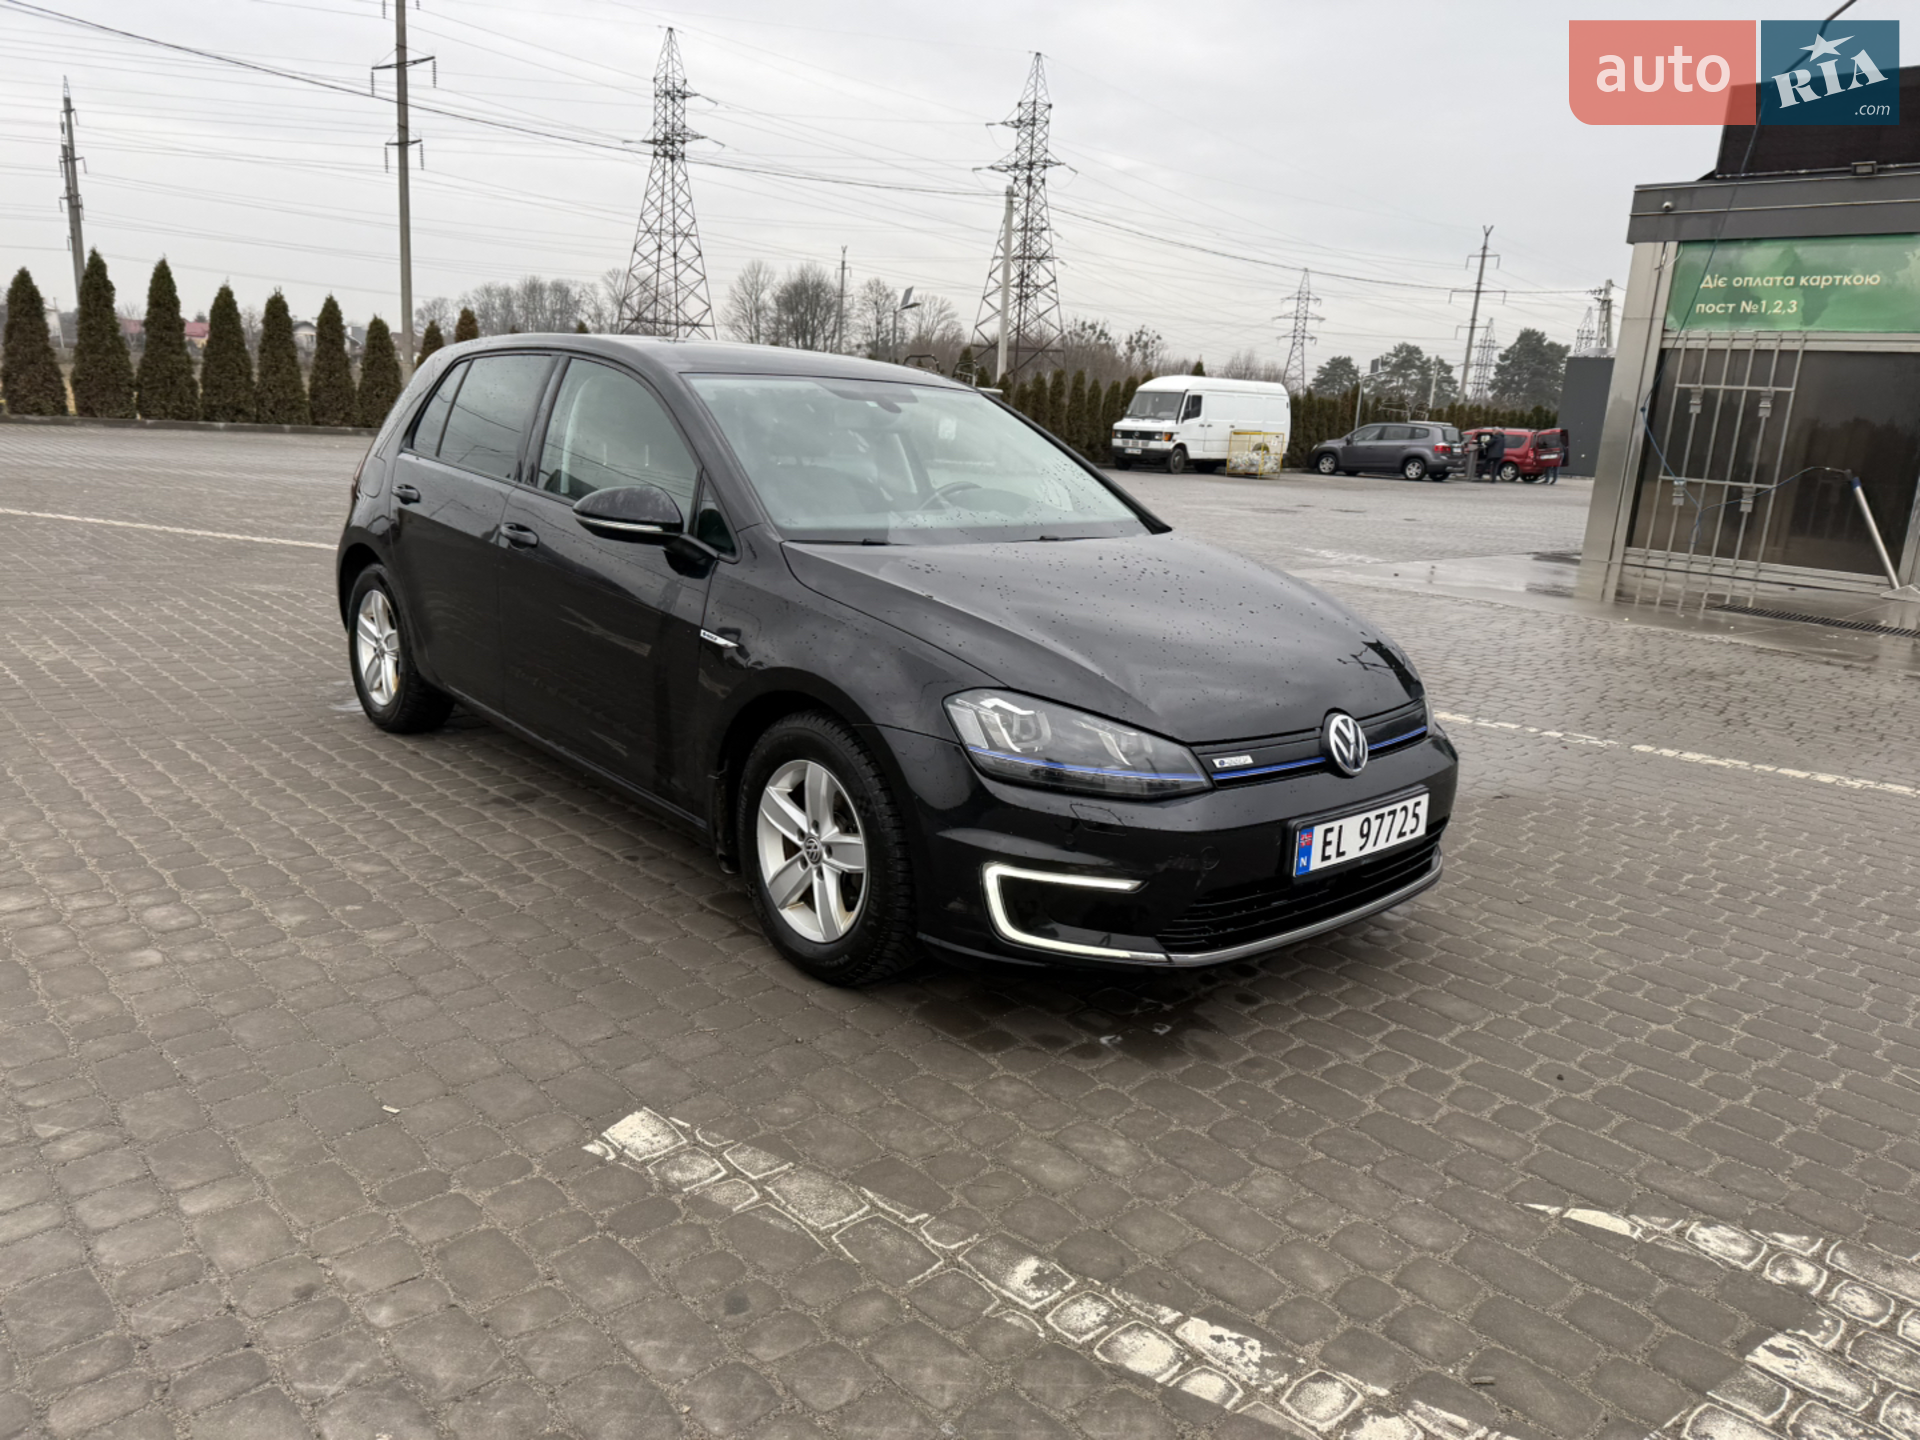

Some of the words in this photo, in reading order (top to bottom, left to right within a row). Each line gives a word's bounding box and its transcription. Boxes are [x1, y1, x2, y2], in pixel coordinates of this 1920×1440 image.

[1699, 273, 1728, 289] Діє
[1732, 274, 1796, 288] оплата
[1799, 273, 1881, 289] карткою
[1695, 302, 1736, 314] пост
[1320, 824, 1346, 863] EL
[1358, 800, 1422, 852] 97725
[1299, 855, 1308, 868] N
